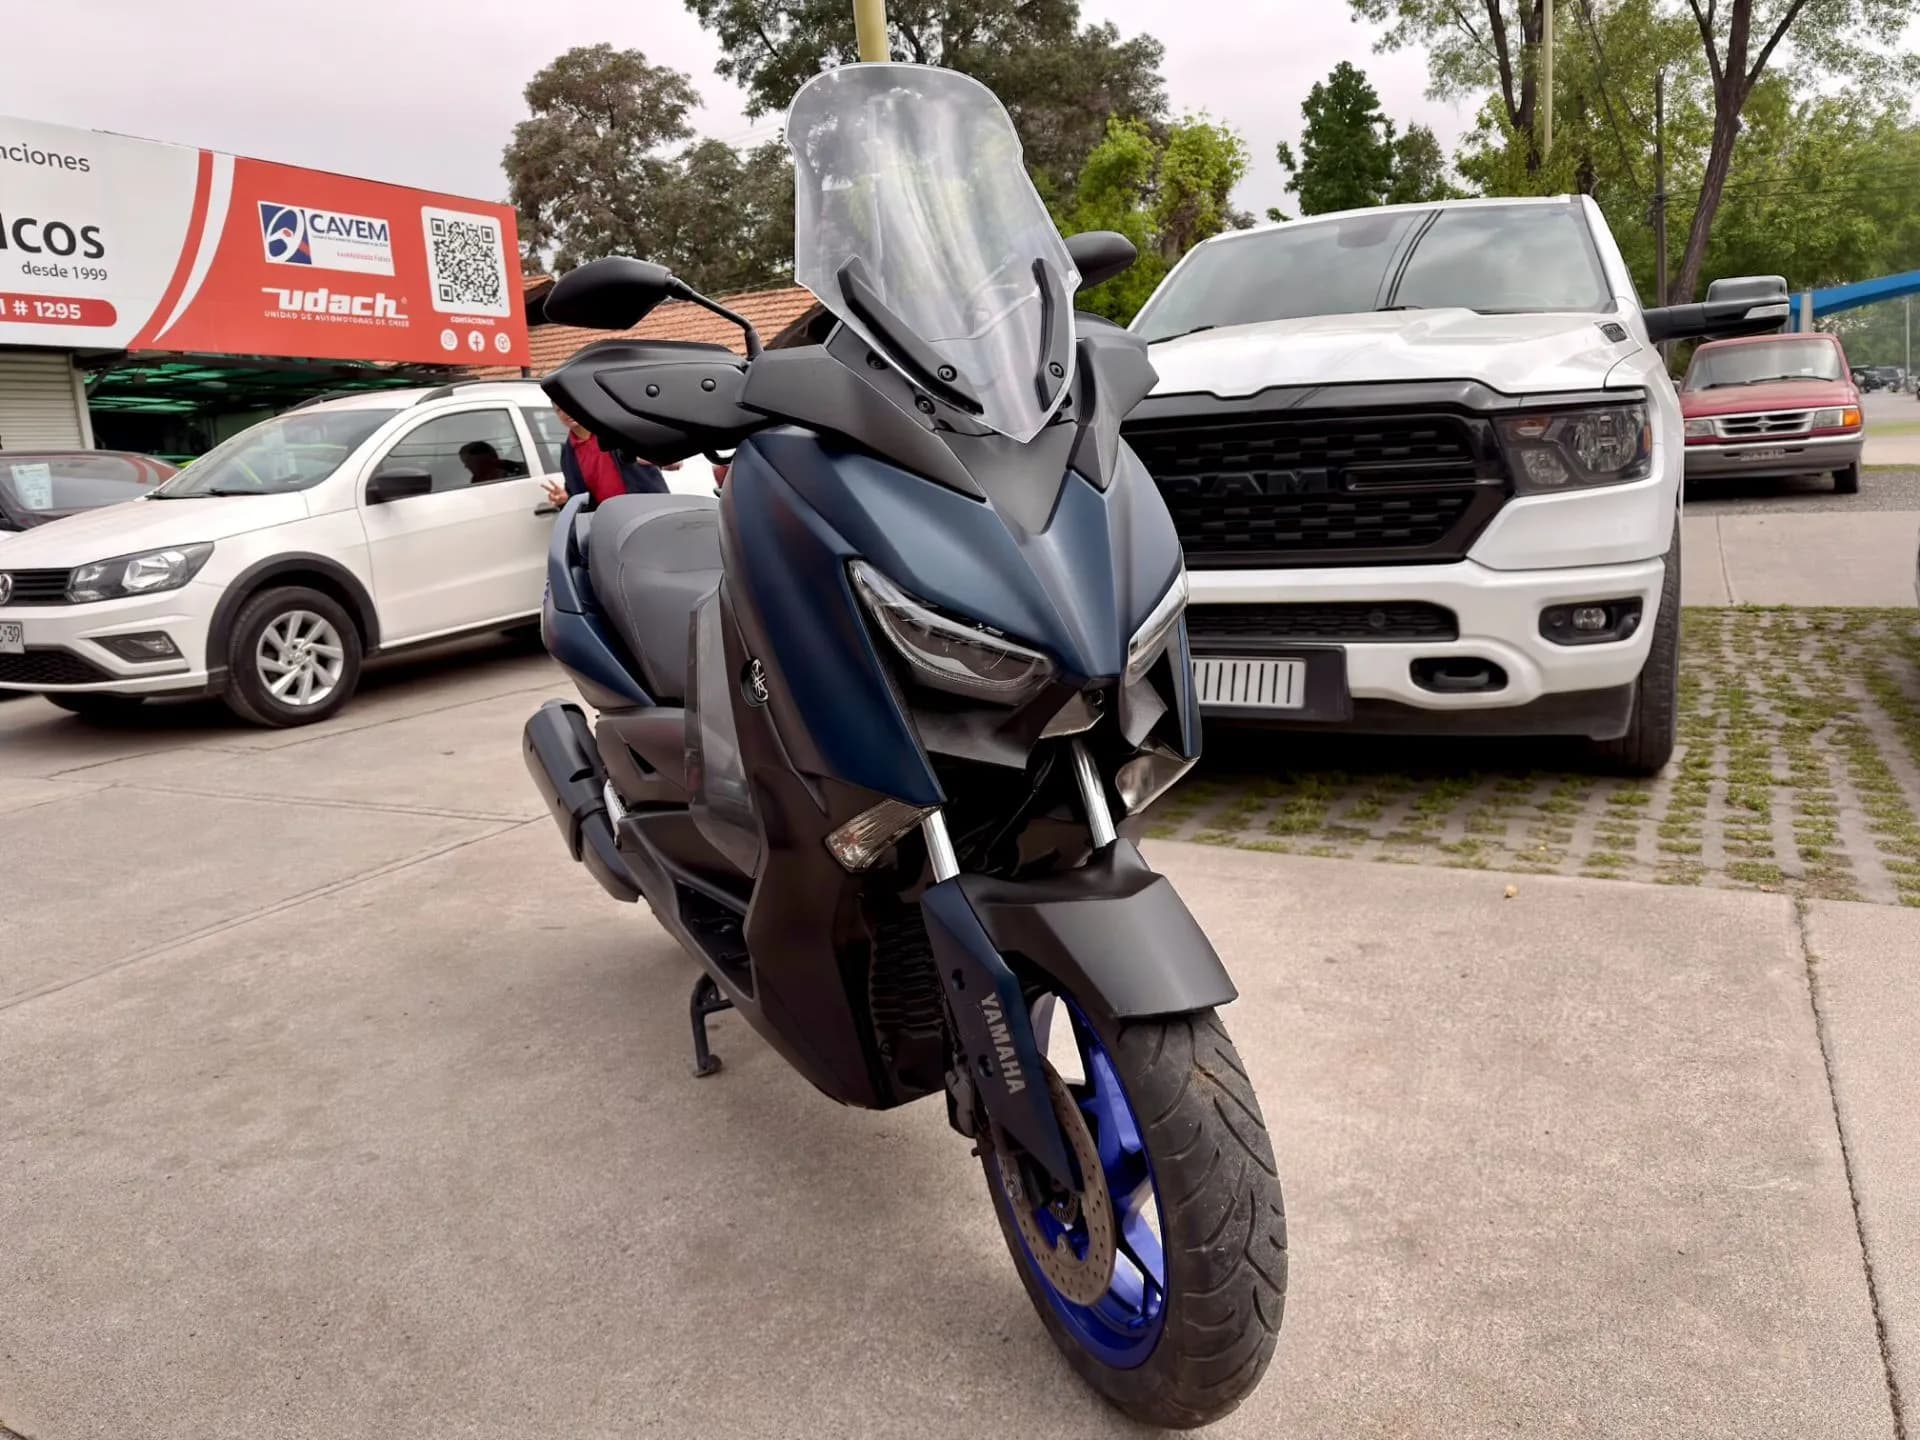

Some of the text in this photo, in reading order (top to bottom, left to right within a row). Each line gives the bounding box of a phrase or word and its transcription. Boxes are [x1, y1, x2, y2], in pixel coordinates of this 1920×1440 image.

[309, 213, 389, 242] CAVEM
[21, 260, 108, 281] desde 1999
[33, 301, 82, 320] 1295
[981, 991, 1026, 1095] YAMAHA
